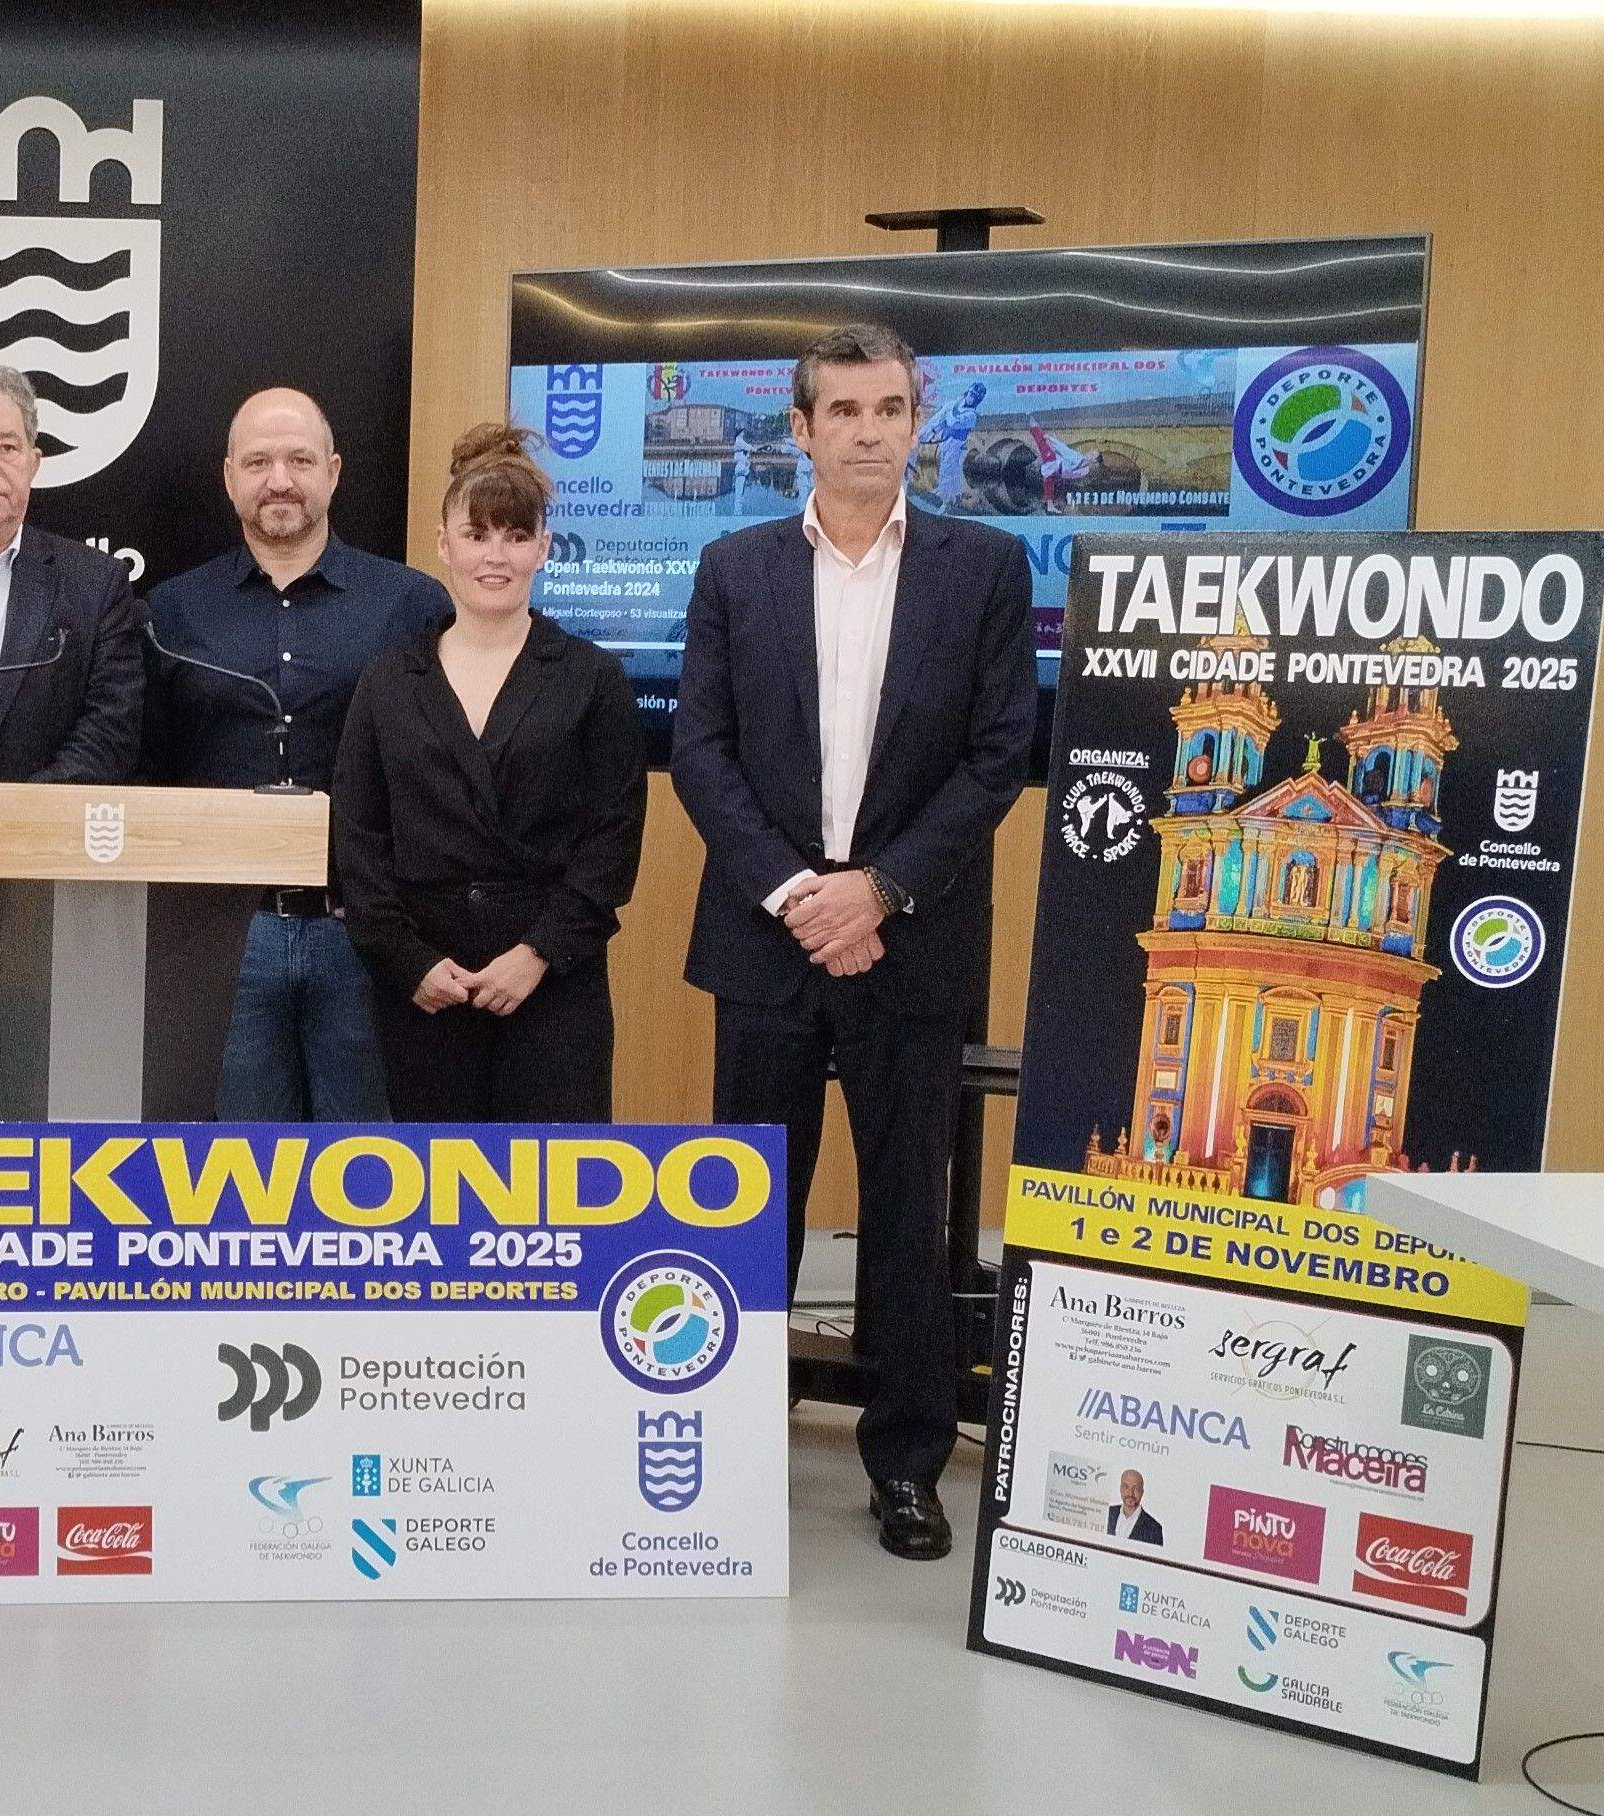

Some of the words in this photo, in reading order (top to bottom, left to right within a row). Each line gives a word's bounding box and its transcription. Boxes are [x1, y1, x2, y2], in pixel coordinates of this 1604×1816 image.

[1266, 369, 1379, 408] DEPORTE
[1255, 432, 1387, 496] PONTEVEDRA
[552, 475, 614, 495] ncello
[545, 498, 643, 518] ontevedra
[596, 537, 689, 555] Deputación
[544, 560, 580, 577] Open
[583, 560, 664, 575] Taekwondo
[665, 560, 700, 575] XXV
[543, 581, 622, 596] Pontevedra
[624, 582, 661, 597] 2024
[1089, 553, 1584, 642] TAEKWONDO
[1082, 648, 1157, 678] XXVII
[1169, 651, 1274, 683] CIDADE
[1287, 652, 1486, 688] PONTEVEDRA
[1501, 657, 1579, 691] 2025
[1069, 748, 1150, 767] ORGANIZA:
[1062, 780, 1087, 810] CLUB
[1085, 771, 1146, 814] TAEKWONDO
[1102, 827, 1142, 863] SPORT
[1479, 839, 1542, 856] Concello
[1458, 853, 1478, 867] de
[1479, 854, 1561, 873] Pontevedra
[1021, 1178, 1136, 1213] PAVILLÓN
[1147, 1197, 1290, 1237] MUNICIPAL
[1303, 1219, 1360, 1246] DOS
[117, 1231, 443, 1268] PONTEVEDRA
[469, 1231, 583, 1268] 2025
[1070, 1217, 1085, 1240] 1
[1100, 1226, 1120, 1246] e
[1131, 1225, 1152, 1251] 2
[1165, 1230, 1213, 1261] DE
[1225, 1240, 1450, 1298] NOVEMBRO
[53, 1276, 193, 1301] PAVILLÓN
[200, 1281, 356, 1300] MUNICIPAL
[363, 1281, 422, 1300] DOS
[433, 1281, 579, 1300] DEPORTES
[625, 1271, 713, 1302] DEPORTE
[1048, 1285, 1098, 1316] Ana
[1104, 1293, 1188, 1330] Barros
[618, 1325, 721, 1377] PONTEVEDRA
[1208, 1329, 1358, 1391] sergraf
[340, 1351, 526, 1387] Deputación
[340, 1386, 526, 1411] Pontevedra
[994, 1277, 1028, 1502] PATROCINADORES:
[48, 1424, 87, 1443] Ana
[92, 1424, 155, 1443] Barros
[1074, 1424, 1116, 1445] Sentir
[1118, 1435, 1170, 1457] común
[388, 1457, 455, 1474] XUNTA
[1052, 1462, 1089, 1481] MGS
[1282, 1424, 1428, 1494] Maceira
[388, 1476, 412, 1493] DE
[418, 1476, 495, 1493] GALICIA
[405, 1517, 496, 1533] DEPORTE
[405, 1536, 486, 1551] GALEGO
[621, 1531, 719, 1551] Concello
[999, 1535, 1089, 1567] COLABORAN:
[589, 1557, 618, 1577] de
[623, 1557, 753, 1577] Pontevedra
[1029, 1598, 1087, 1619] Pontevedra
[1031, 1588, 1088, 1609] Deputación
[1143, 1590, 1186, 1610] XUNTA
[1141, 1603, 1158, 1617] DE
[1161, 1607, 1212, 1630] GALICIA
[1284, 1613, 1348, 1639] DEPORTE
[1283, 1627, 1340, 1650] GALEGO
[1282, 1676, 1331, 1698] GALICIA
[1281, 1688, 1345, 1715] SAUDABLE
